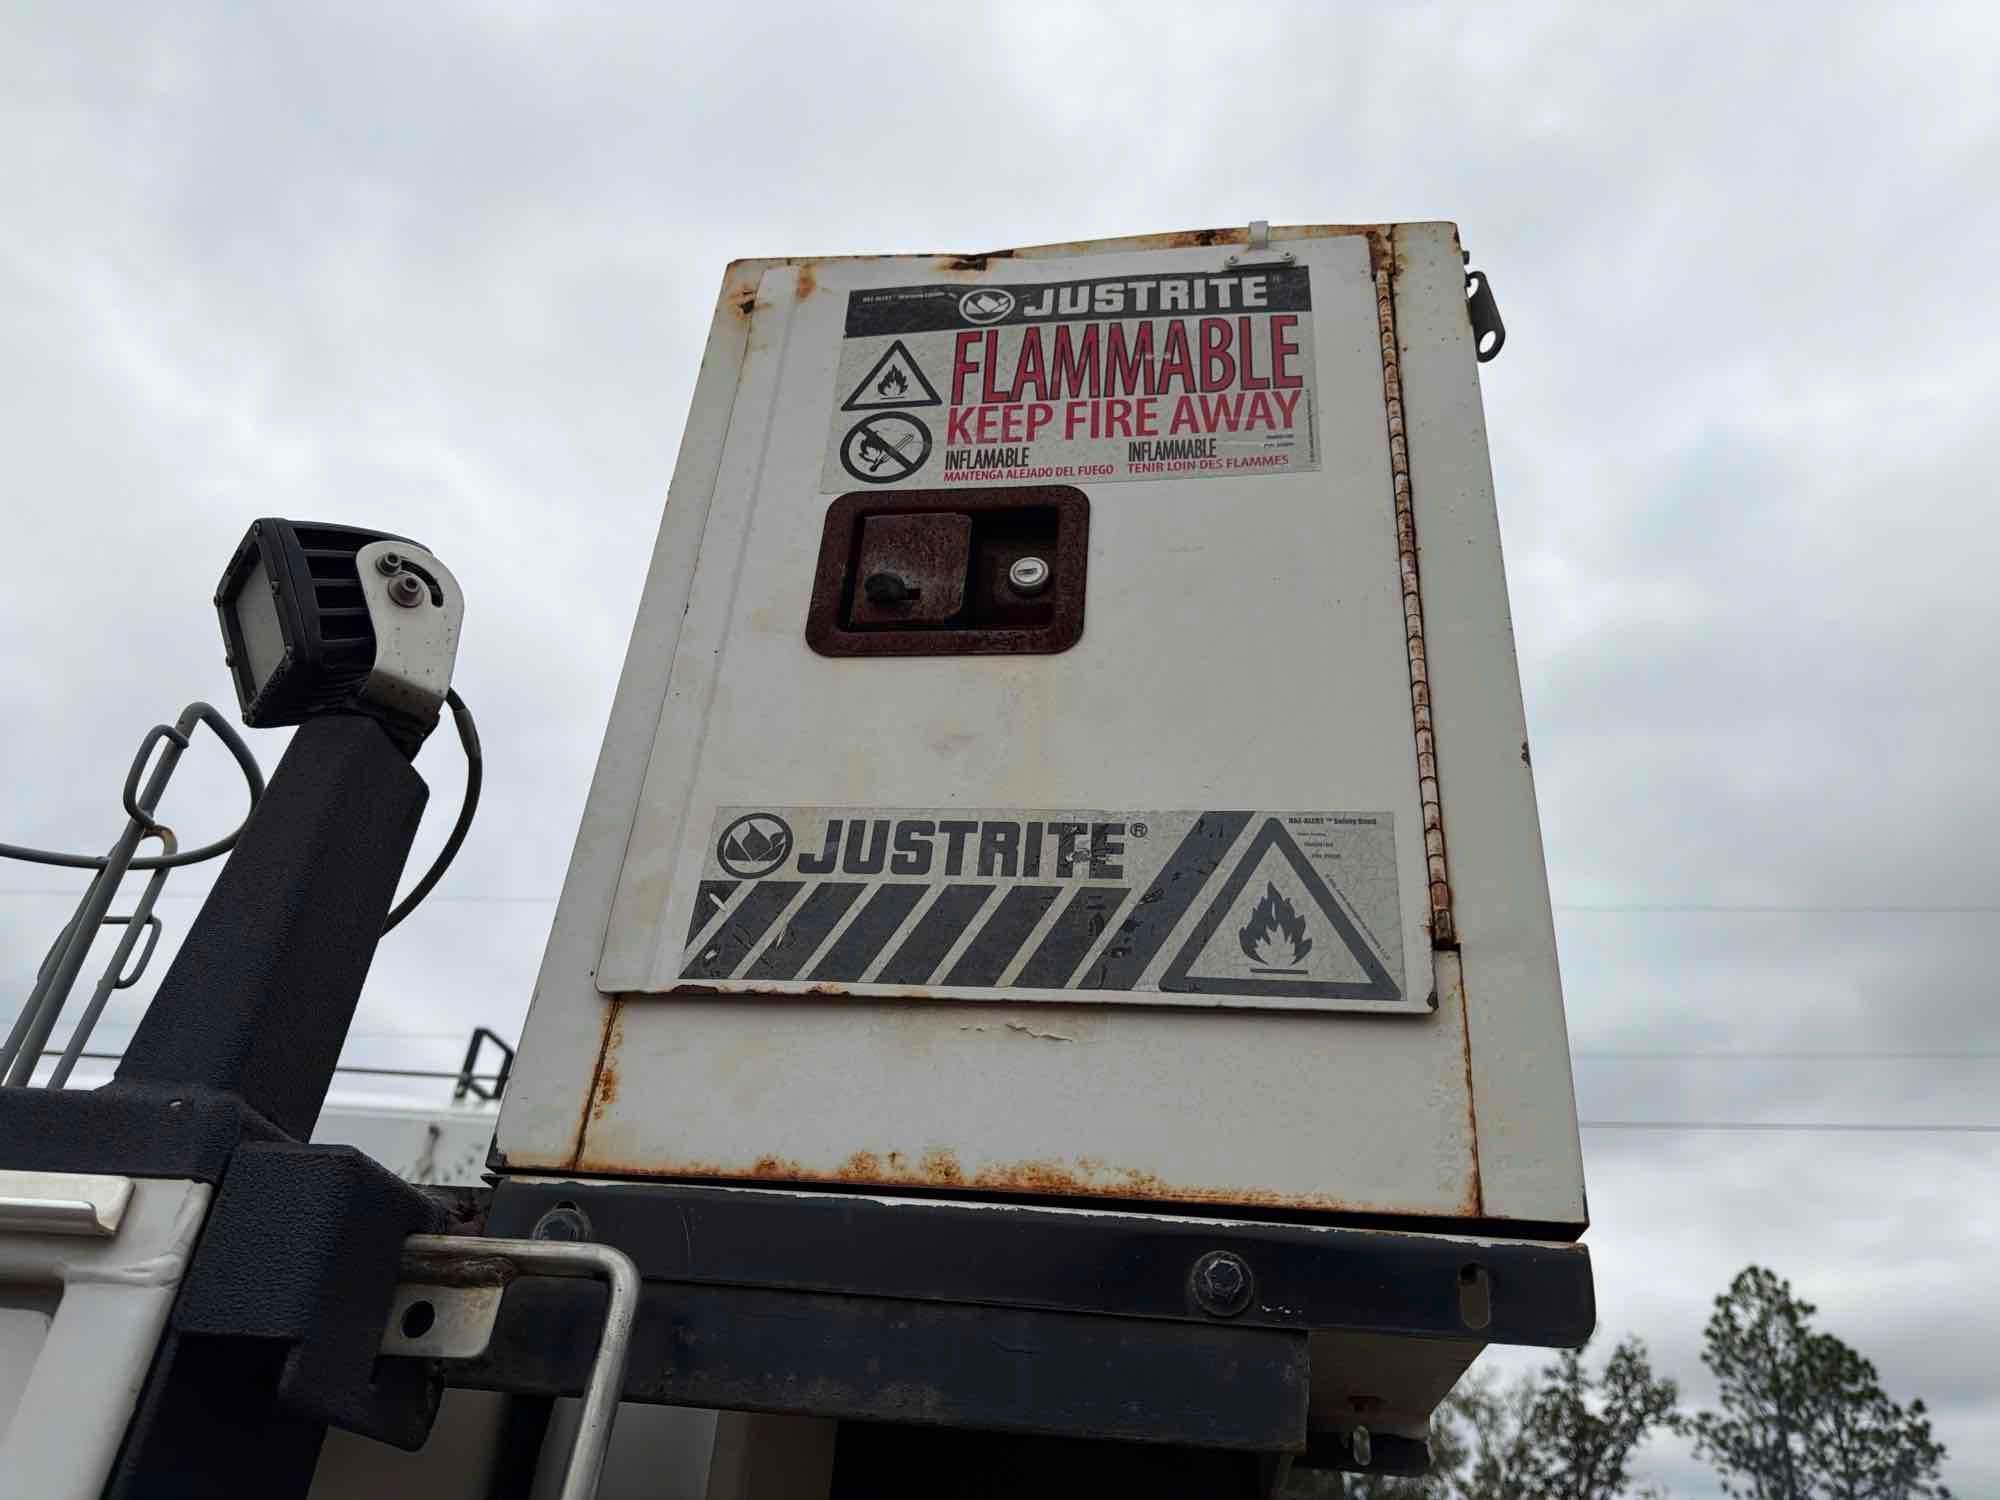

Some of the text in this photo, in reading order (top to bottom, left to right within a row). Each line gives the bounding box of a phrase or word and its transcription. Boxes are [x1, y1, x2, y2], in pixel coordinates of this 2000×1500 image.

[951, 314, 1304, 407] FLAMMABLE
[946, 402, 1054, 447] KEEP
[1064, 397, 1159, 441] FIRE
[1168, 389, 1302, 436] AWAY
[944, 446, 1031, 471] INFLAMABLE
[1128, 437, 1217, 463] INFLAMMABLE
[943, 463, 1114, 483] MANTENGA ALEJADO DEL FUEGO
[1128, 454, 1289, 474] TENIR LOIN DES FLAMMES
